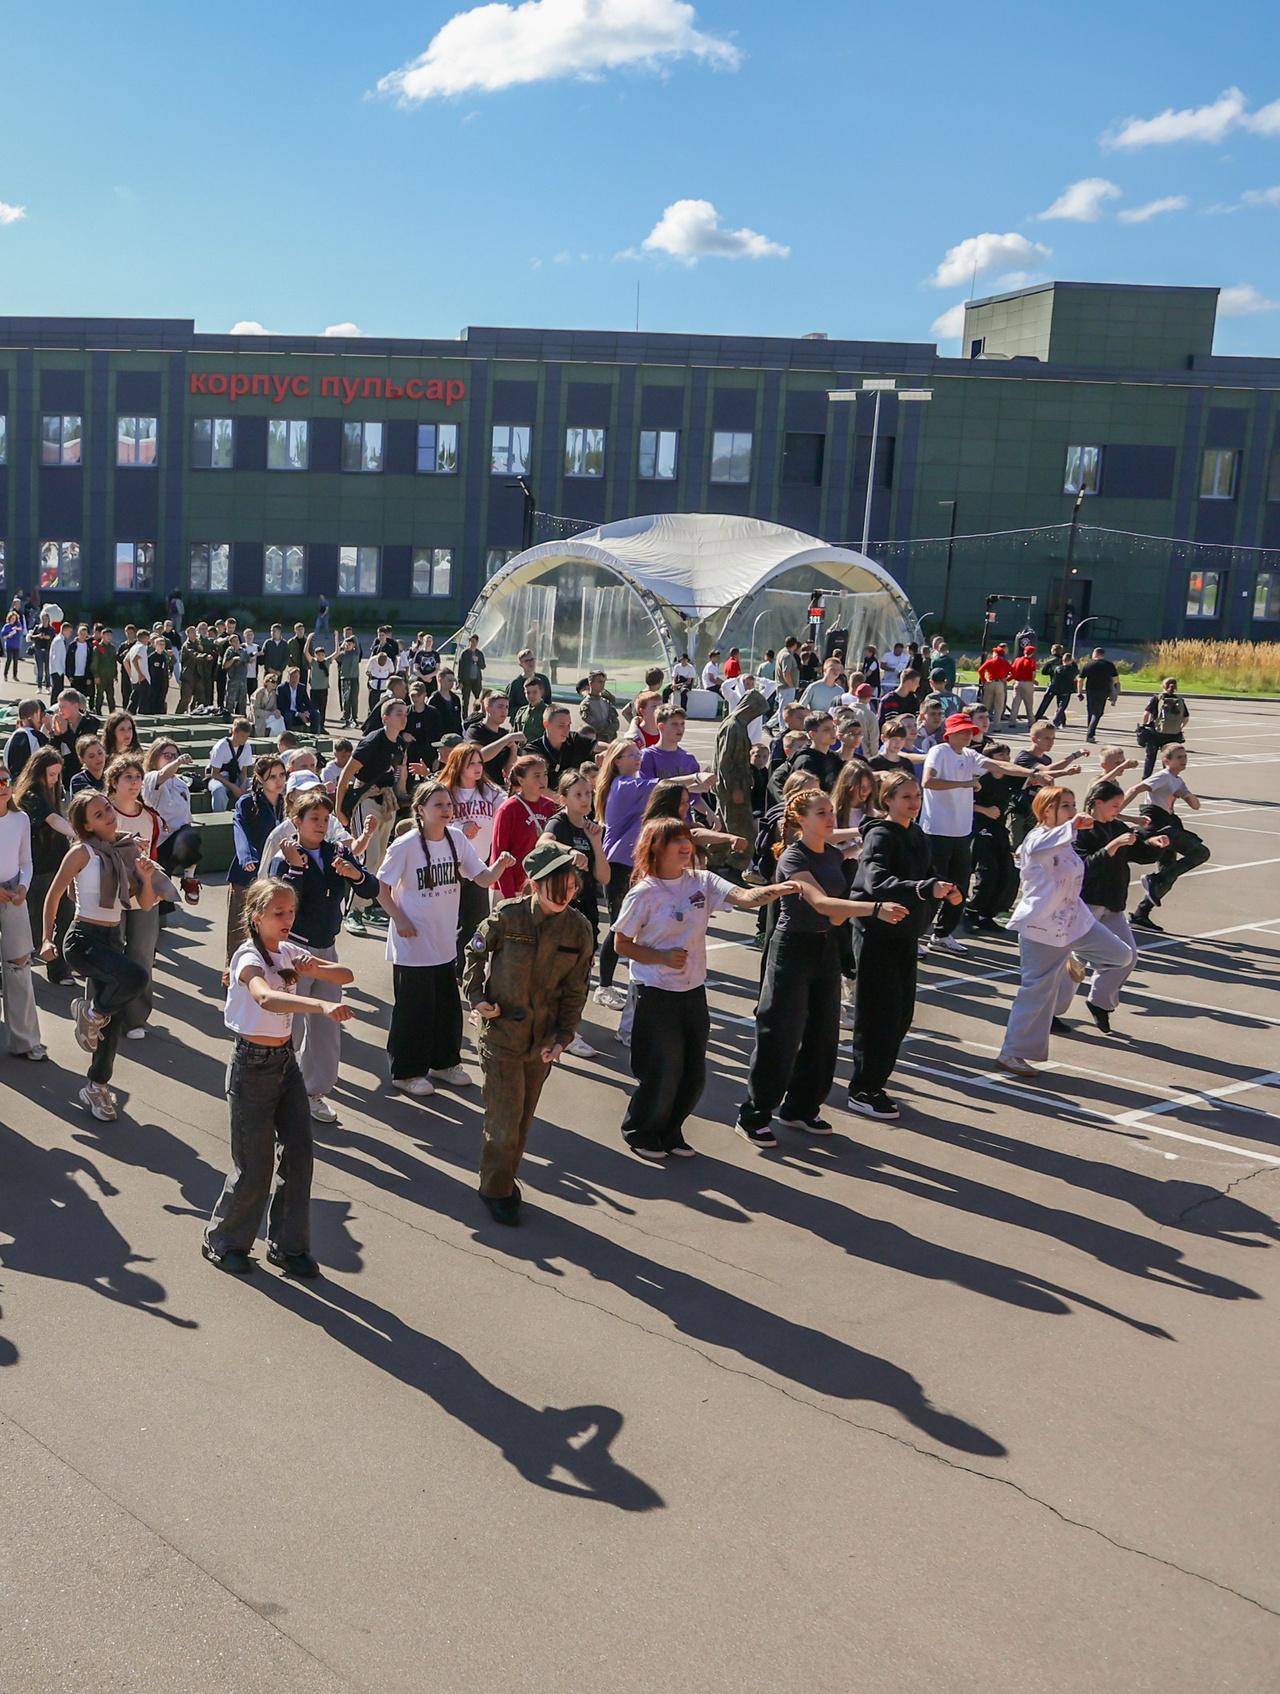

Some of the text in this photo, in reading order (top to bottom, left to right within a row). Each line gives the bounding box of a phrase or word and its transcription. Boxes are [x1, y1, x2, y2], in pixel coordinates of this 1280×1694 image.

[191, 373, 466, 406] корпус пульсар
[451, 800, 494, 819] ARVARD
